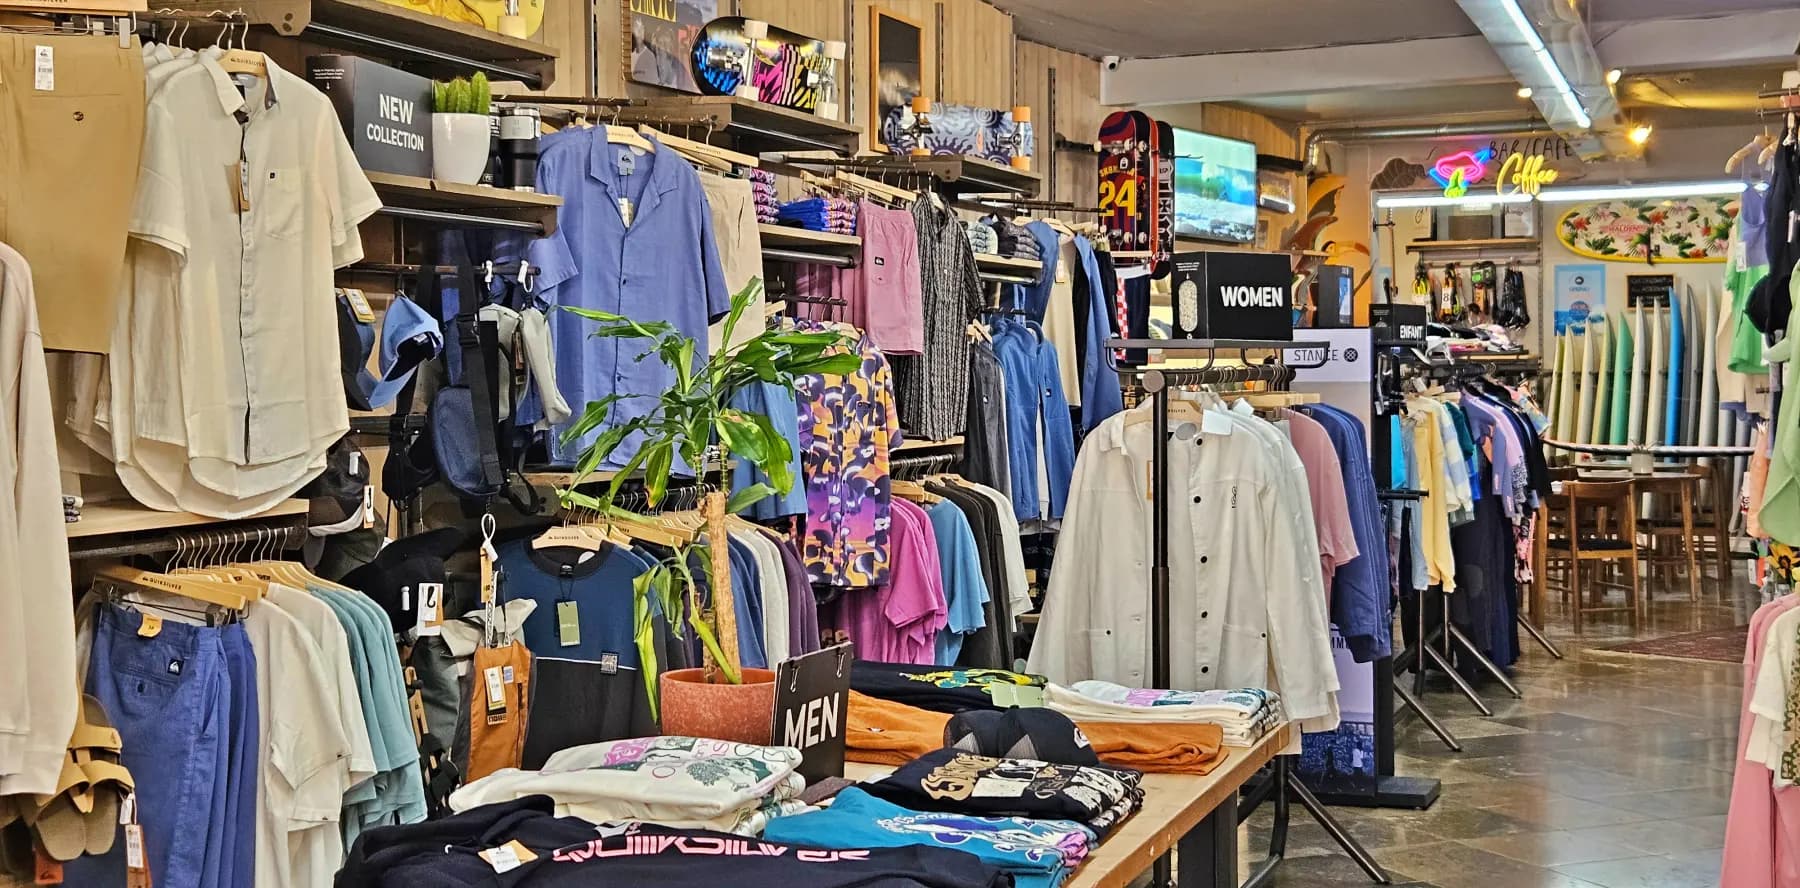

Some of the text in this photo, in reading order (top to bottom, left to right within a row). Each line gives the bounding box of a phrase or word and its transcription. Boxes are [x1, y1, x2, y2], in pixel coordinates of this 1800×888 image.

[380, 93, 414, 125] NEW
[366, 122, 424, 152] COLLECTION
[1496, 151, 1559, 196] Coffee
[1098, 180, 1136, 217] 24
[1220, 285, 1283, 308] WOMEN
[1400, 324, 1423, 339] ENFANT
[149, 577, 182, 590] QUIKSILVER
[784, 692, 840, 750] MEN
